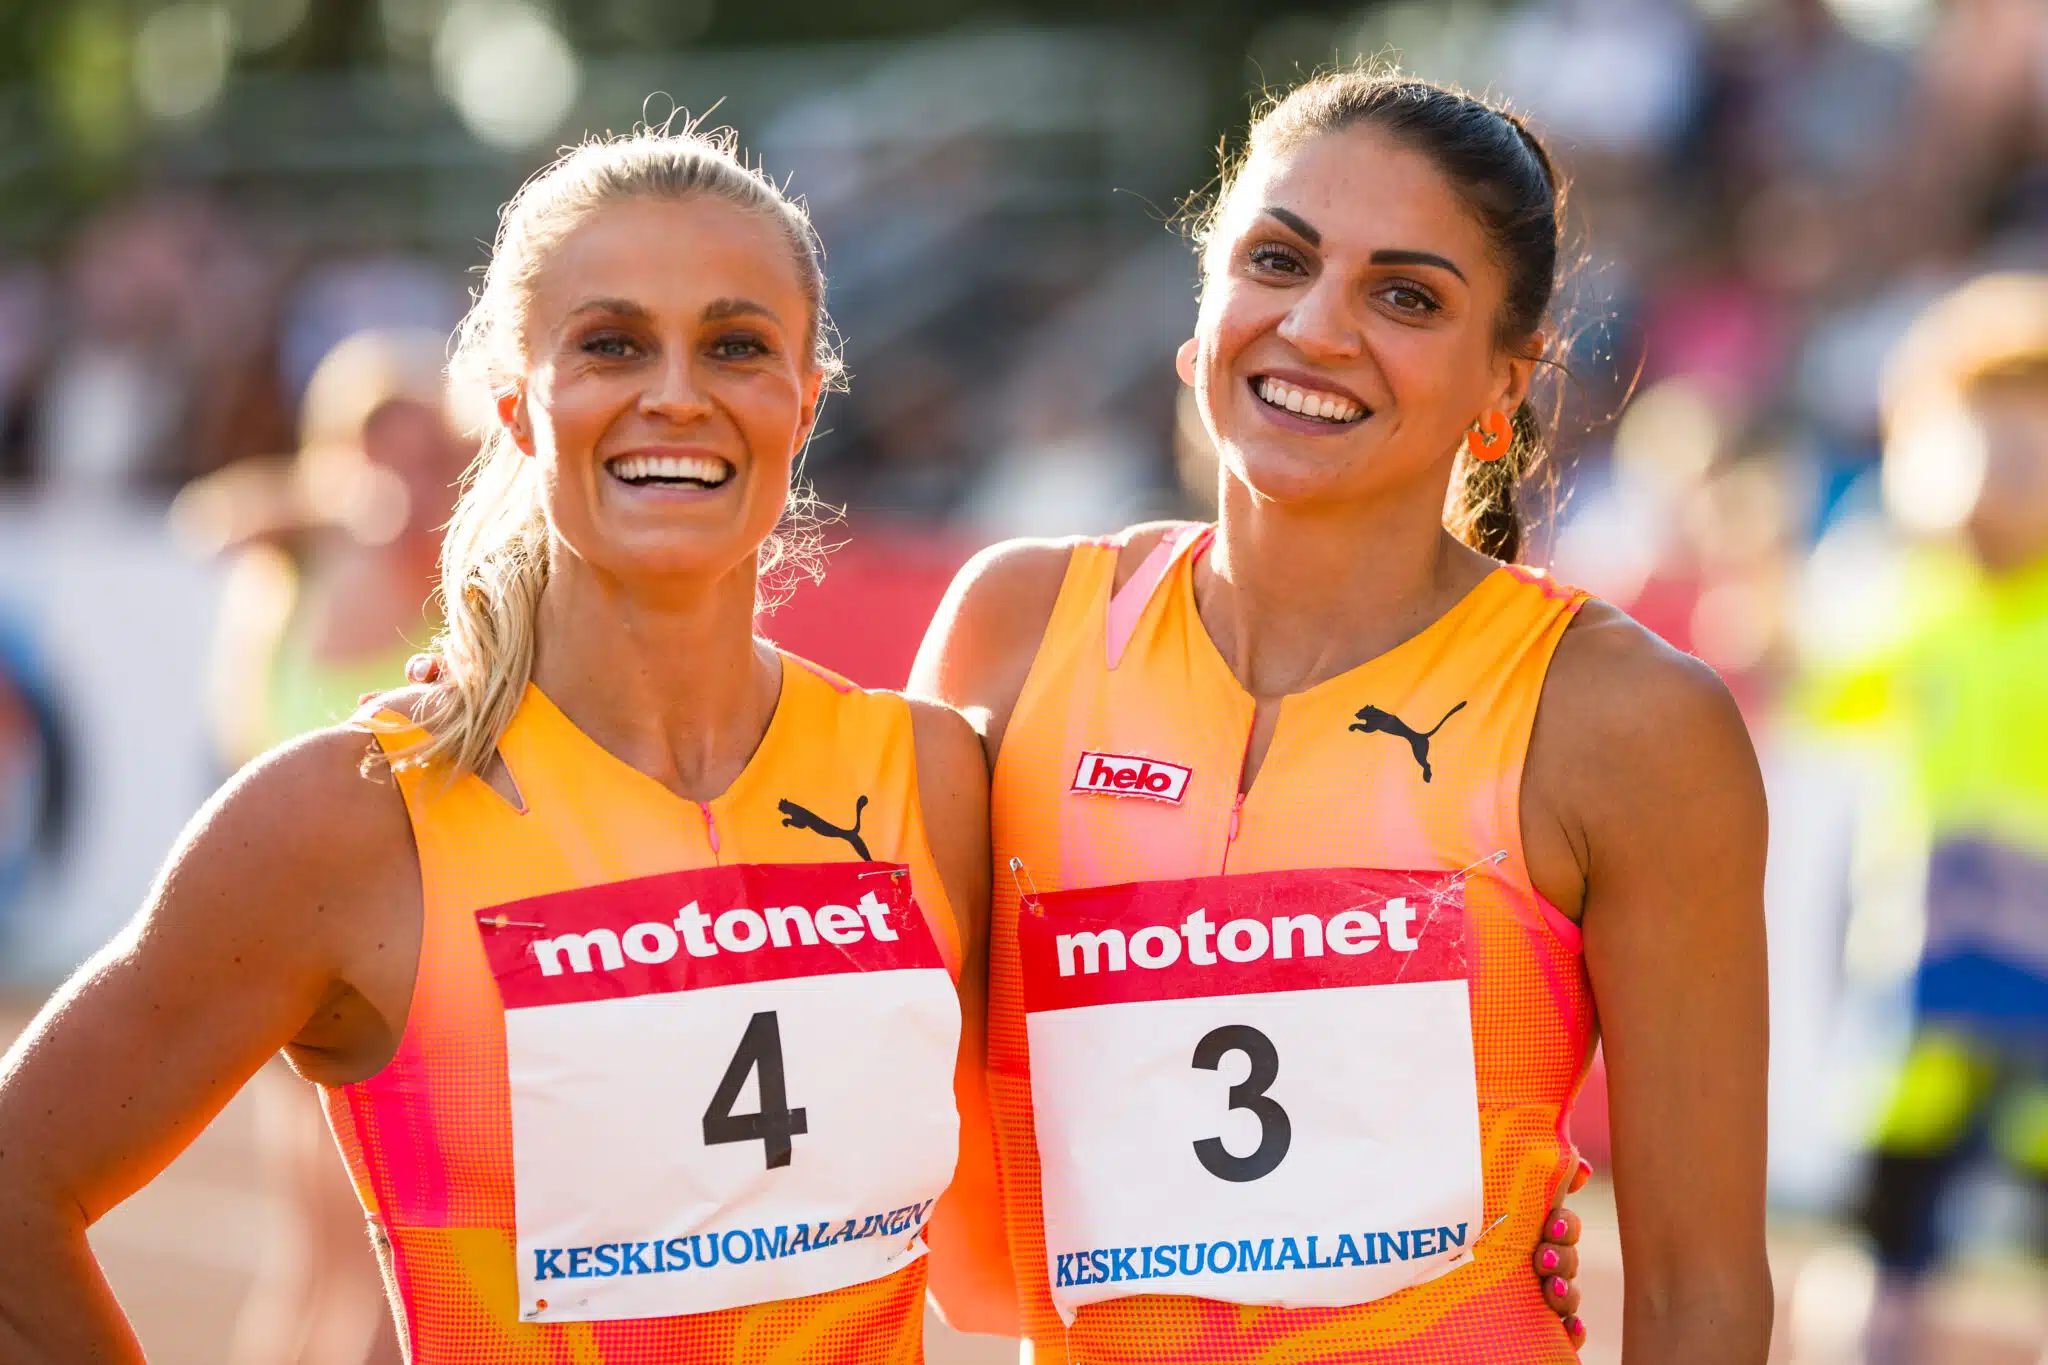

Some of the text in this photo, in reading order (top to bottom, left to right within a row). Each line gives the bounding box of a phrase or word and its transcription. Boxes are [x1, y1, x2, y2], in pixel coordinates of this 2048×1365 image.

[1088, 757, 1172, 793] helo
[533, 889, 900, 977] motonet
[1055, 896, 1419, 978] motonet
[701, 1010, 809, 1171] 4
[1191, 1024, 1292, 1183] 3
[533, 1198, 934, 1282] KESKISUOMALAINEN
[1055, 1222, 1469, 1289] KESKISUOMALAINEN
